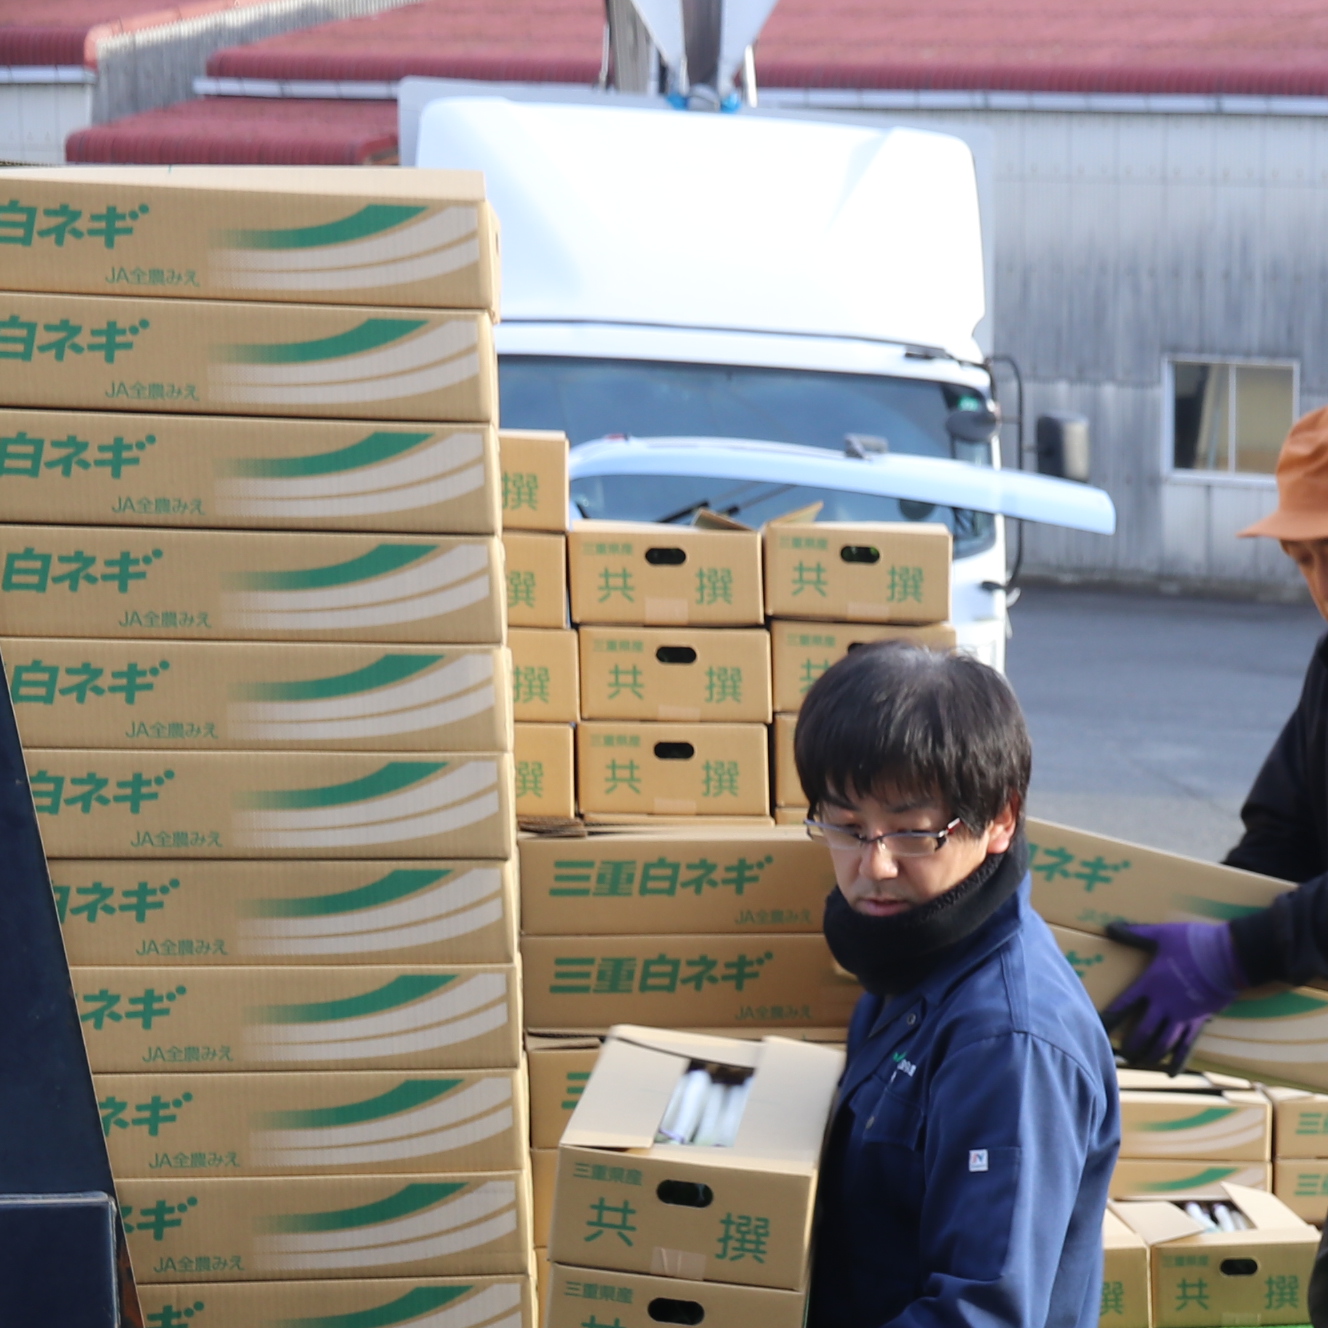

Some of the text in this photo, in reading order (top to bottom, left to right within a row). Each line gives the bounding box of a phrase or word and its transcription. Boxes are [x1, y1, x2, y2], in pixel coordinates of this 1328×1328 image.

[107, 268, 199, 286] JA全農みえ
[106, 382, 198, 400] JA全農みえ
[0, 432, 156, 478] 白ネギ
[113, 498, 204, 514] JA全農みえ
[3, 548, 162, 593] 白ネギ
[599, 568, 732, 604] 共 撰
[793, 563, 923, 602] 共 撰
[120, 611, 210, 627] JA全農みえ
[10, 660, 170, 704] 白ネギ
[609, 665, 742, 702] 共 撰
[127, 722, 218, 738] JA全農みえ
[606, 760, 739, 796] 共 撰
[131, 831, 221, 848] JA全農みえ
[550, 856, 773, 896] 三重白ネギ
[137, 940, 226, 955] JA全農みえ
[550, 953, 773, 993] 三重白ネギ
[143, 1046, 232, 1062] JA全農みえ
[150, 1152, 239, 1168] JA全農みえ
[576, 1163, 642, 1185] 三重県産
[585, 1198, 770, 1263] 共 撰
[154, 1256, 243, 1273] JA全農みえ
[566, 1282, 633, 1303] 三重県産
[1176, 1276, 1299, 1310] 共 撰
